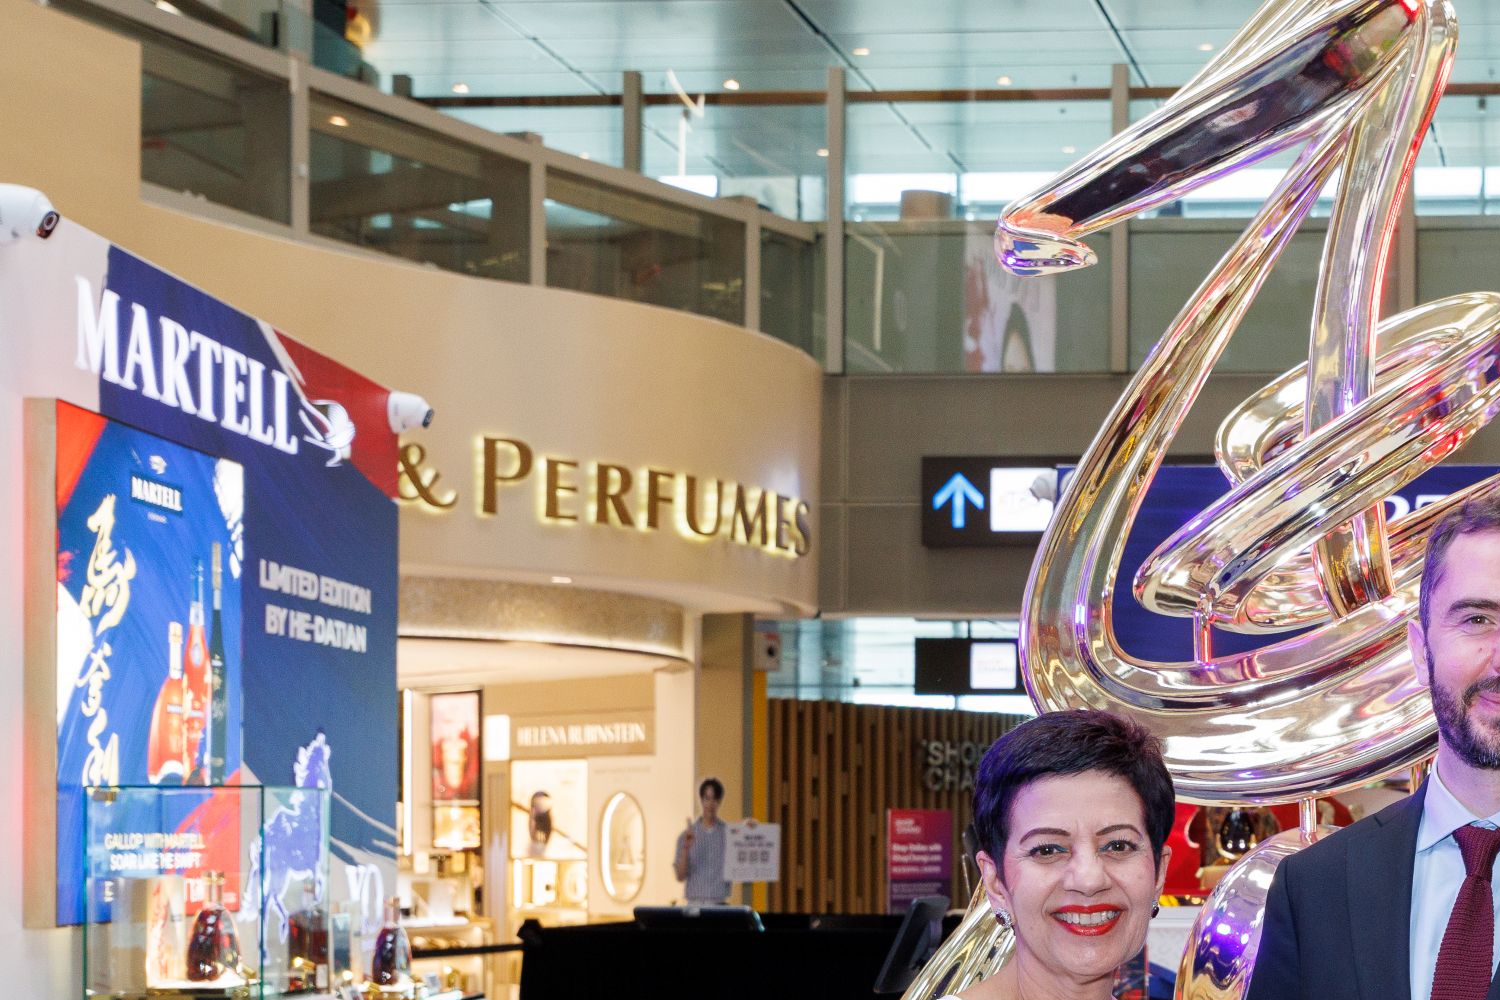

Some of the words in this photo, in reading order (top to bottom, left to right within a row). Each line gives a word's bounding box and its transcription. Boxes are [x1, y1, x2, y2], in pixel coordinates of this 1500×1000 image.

[75, 274, 299, 455] MARTELL
[131, 475, 183, 511] MARTELL
[482, 436, 811, 557] PERFUMES
[259, 558, 319, 601] LIMITED
[319, 574, 371, 615] EDITION
[265, 603, 288, 636] BY
[104, 832, 143, 850] GALLOP
